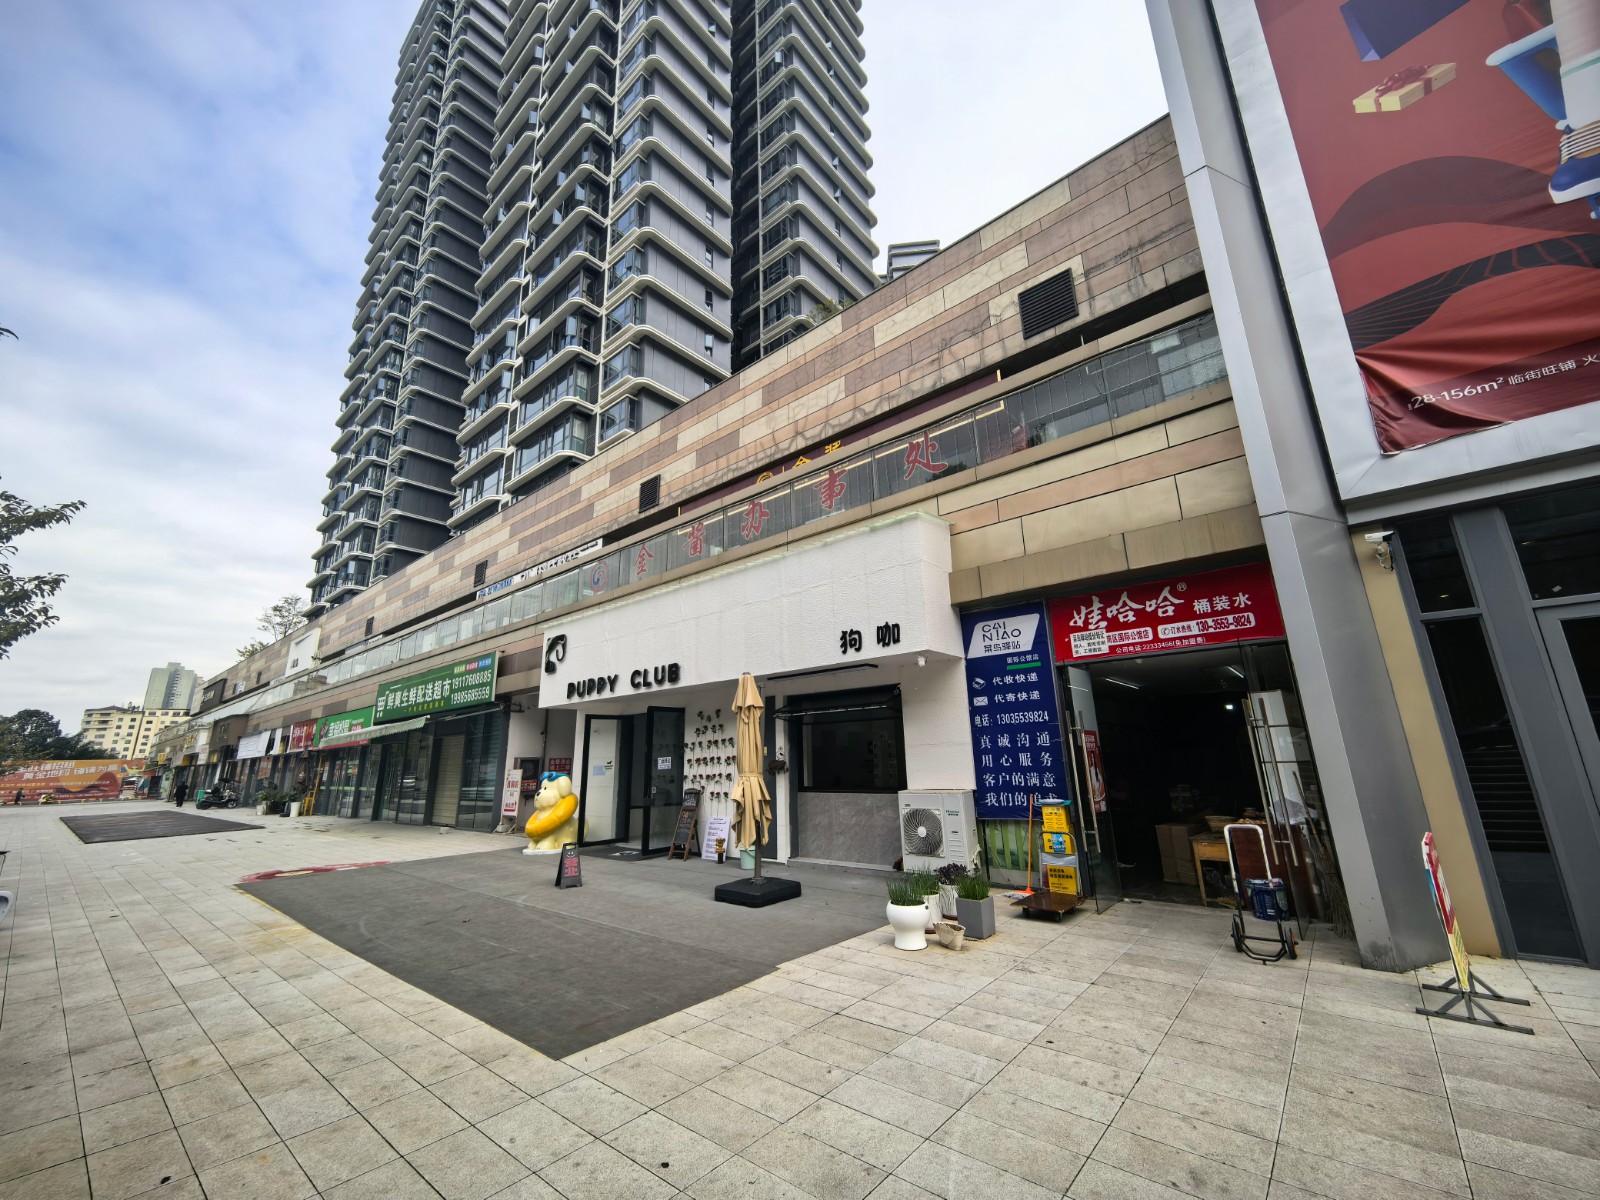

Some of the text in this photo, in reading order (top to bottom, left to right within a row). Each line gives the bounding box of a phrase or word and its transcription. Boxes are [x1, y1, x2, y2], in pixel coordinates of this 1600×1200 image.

[1508, 359, 1577, 386] 临街旺铺
[1069, 586, 1184, 630] 娃哈哈
[1193, 592, 1252, 614] 桶装水
[982, 621, 1002, 633] CAI
[840, 621, 901, 655] 狗咖
[982, 629, 1021, 642] NIAO
[984, 641, 1021, 653] 菜鸟驿站
[1006, 654, 1039, 664] 国际公馆店
[567, 662, 680, 699] PUPPY CLUB
[992, 672, 1039, 686] 代收快递
[994, 690, 1041, 704] 代寄快递
[996, 710, 1049, 725] 13035539824
[980, 731, 1051, 749] 真诚沟通
[981, 752, 1053, 768] 用心服务
[982, 772, 1057, 787] 客户的满意
